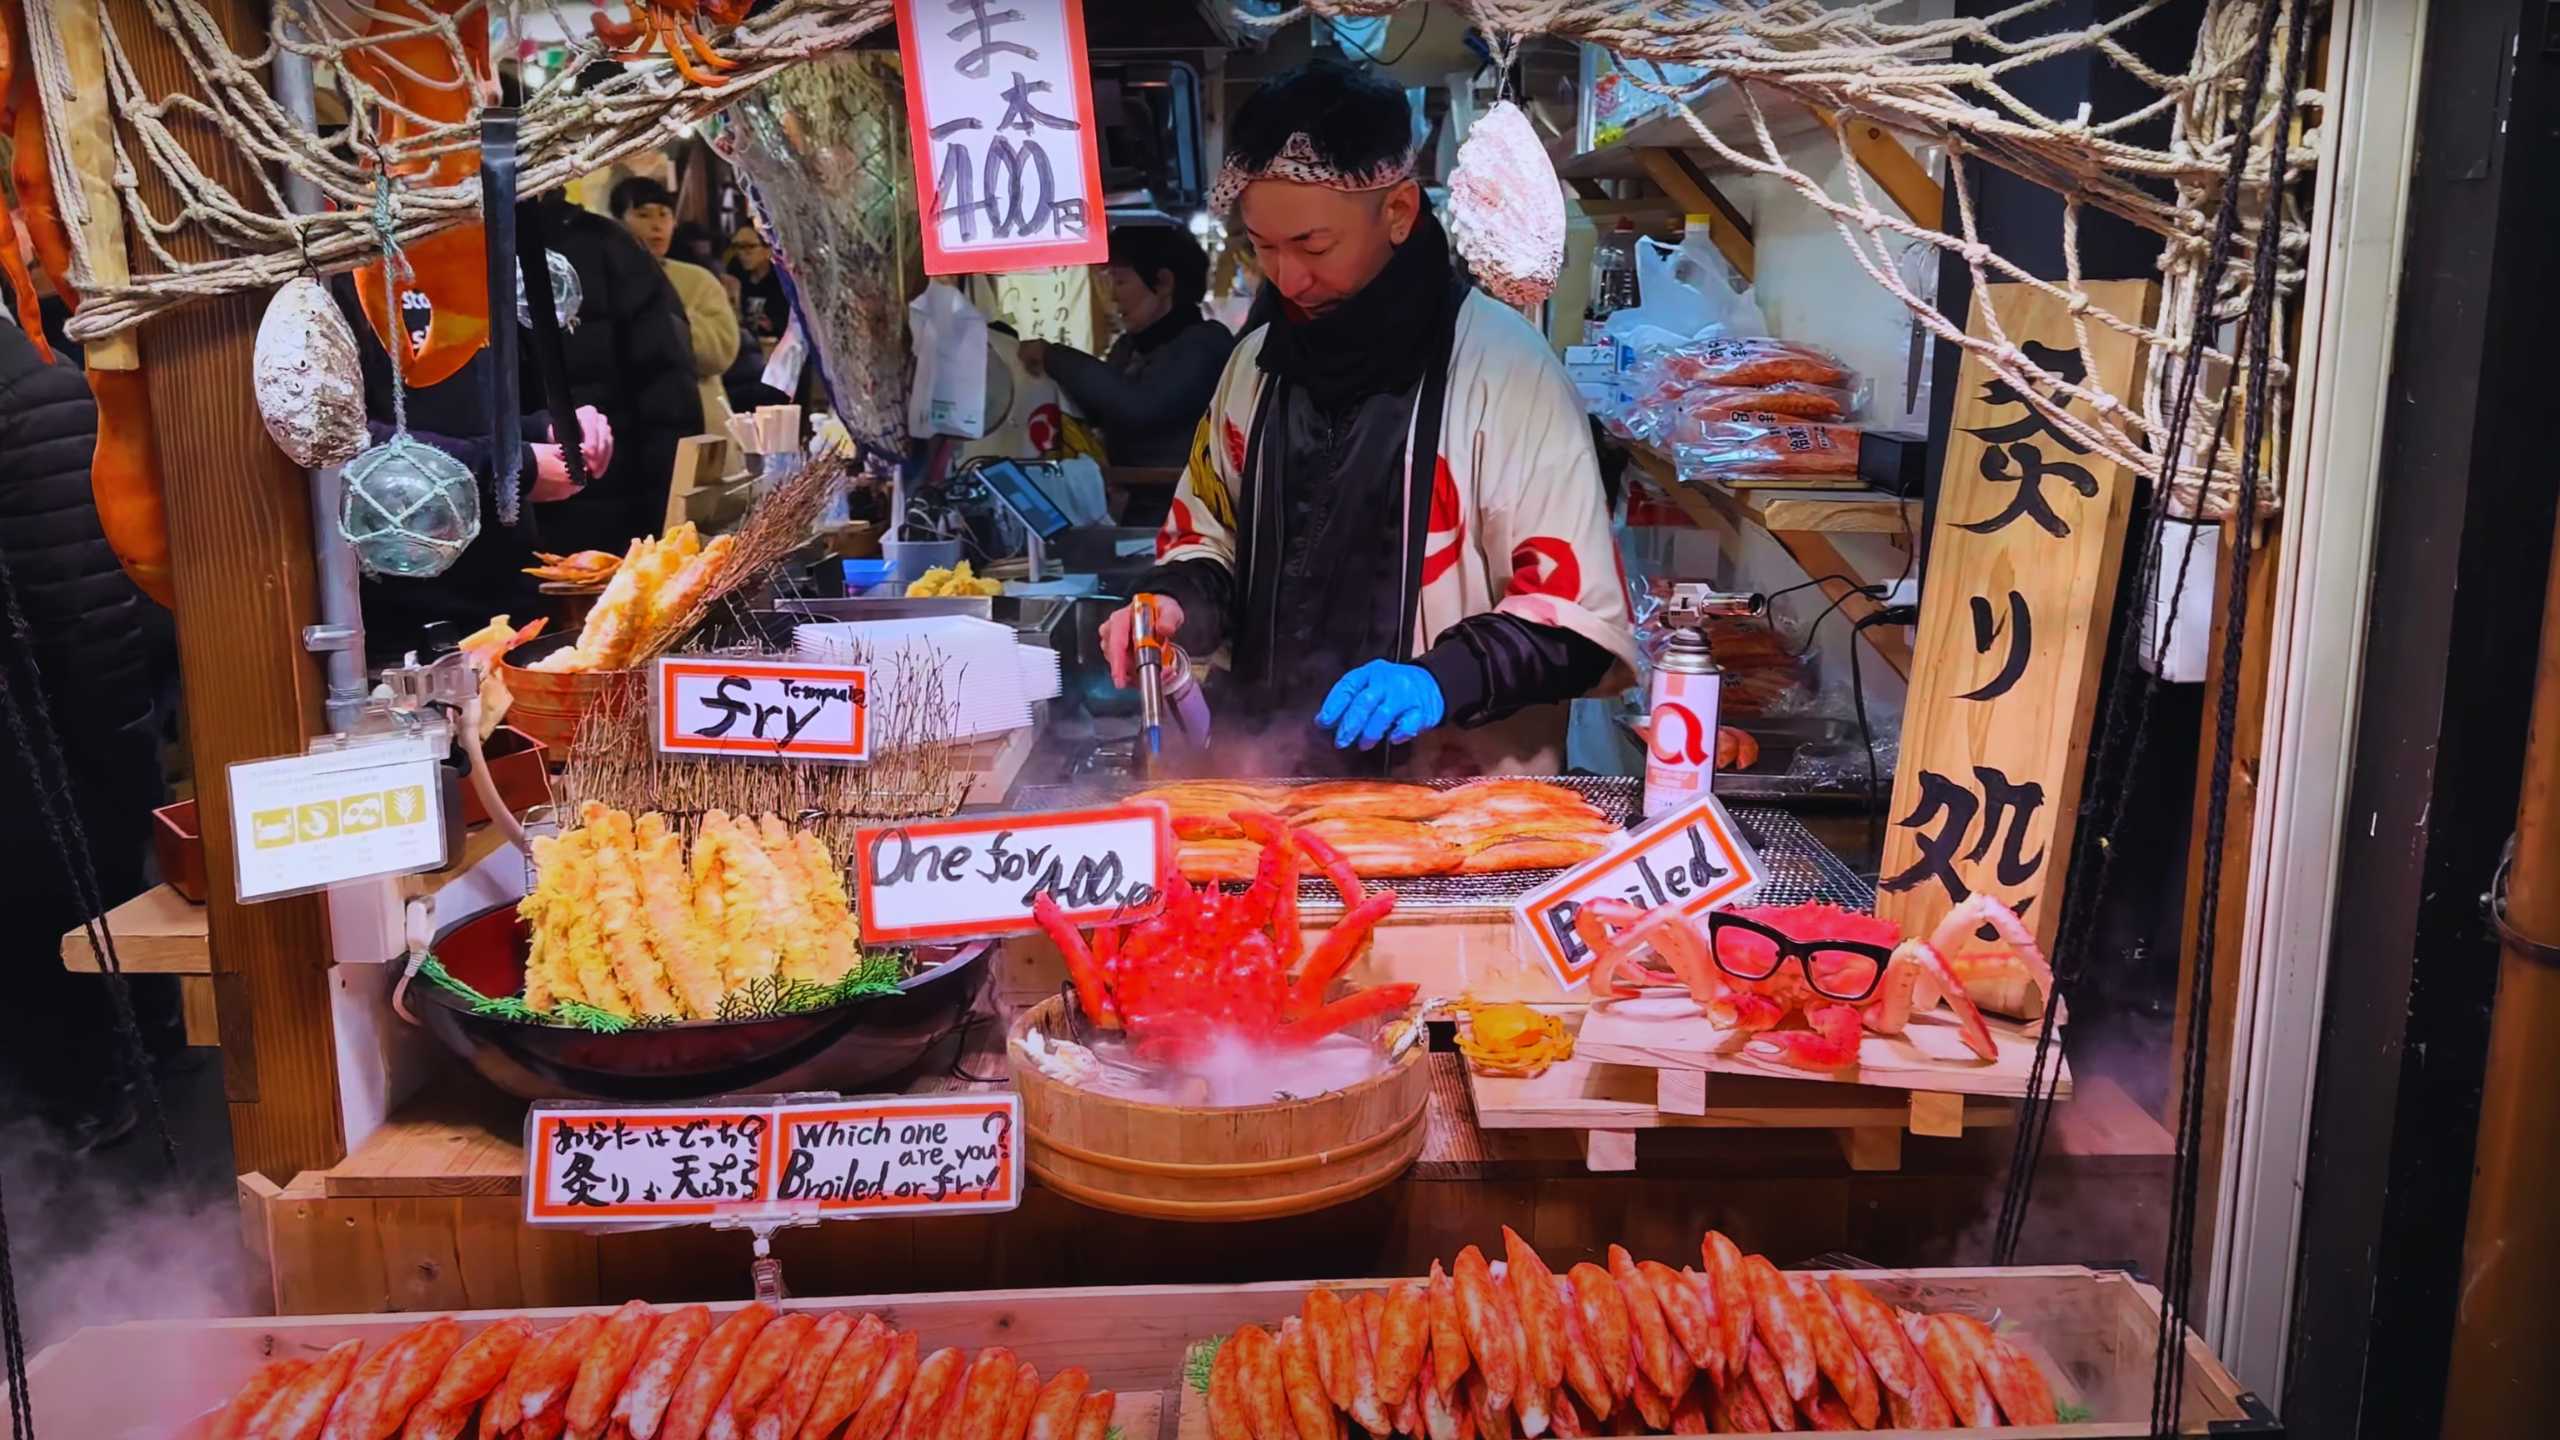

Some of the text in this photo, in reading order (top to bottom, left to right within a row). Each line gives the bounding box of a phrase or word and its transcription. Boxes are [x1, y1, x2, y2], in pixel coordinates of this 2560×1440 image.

[929, 71, 1082, 141] 一本
[870, 827, 972, 887] One
[976, 830, 1053, 884] for
[1021, 850, 1123, 909] 400
[1547, 823, 1729, 964] Biled
[797, 1116, 949, 1148] Which one
[899, 1146, 944, 1167] are
[777, 1148, 1001, 1203] Broiled or fry
